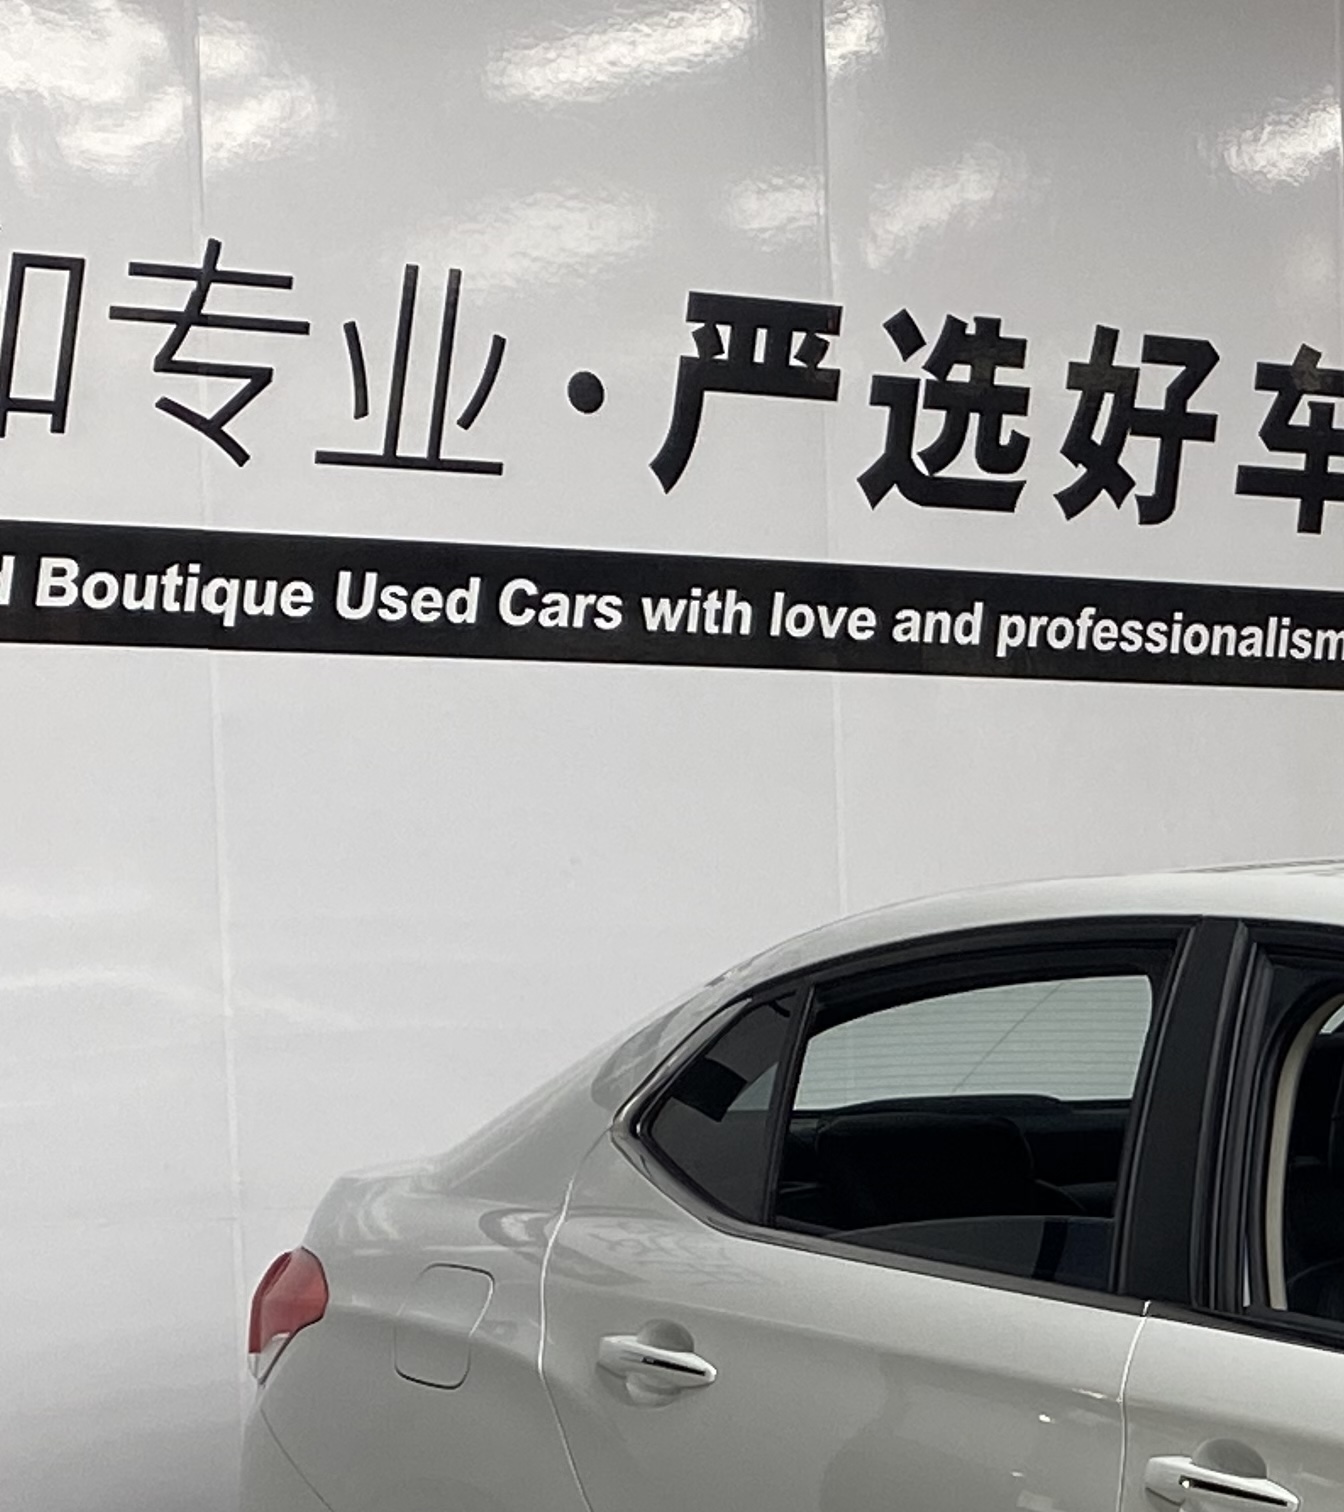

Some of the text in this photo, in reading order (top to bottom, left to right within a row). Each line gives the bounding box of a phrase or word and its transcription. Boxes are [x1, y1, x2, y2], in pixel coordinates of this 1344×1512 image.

[34, 556, 313, 627] Boutique
[334, 571, 481, 623] Used
[499, 578, 622, 630] Cars
[642, 587, 751, 636] with
[768, 592, 877, 641] love
[891, 602, 983, 646] and
